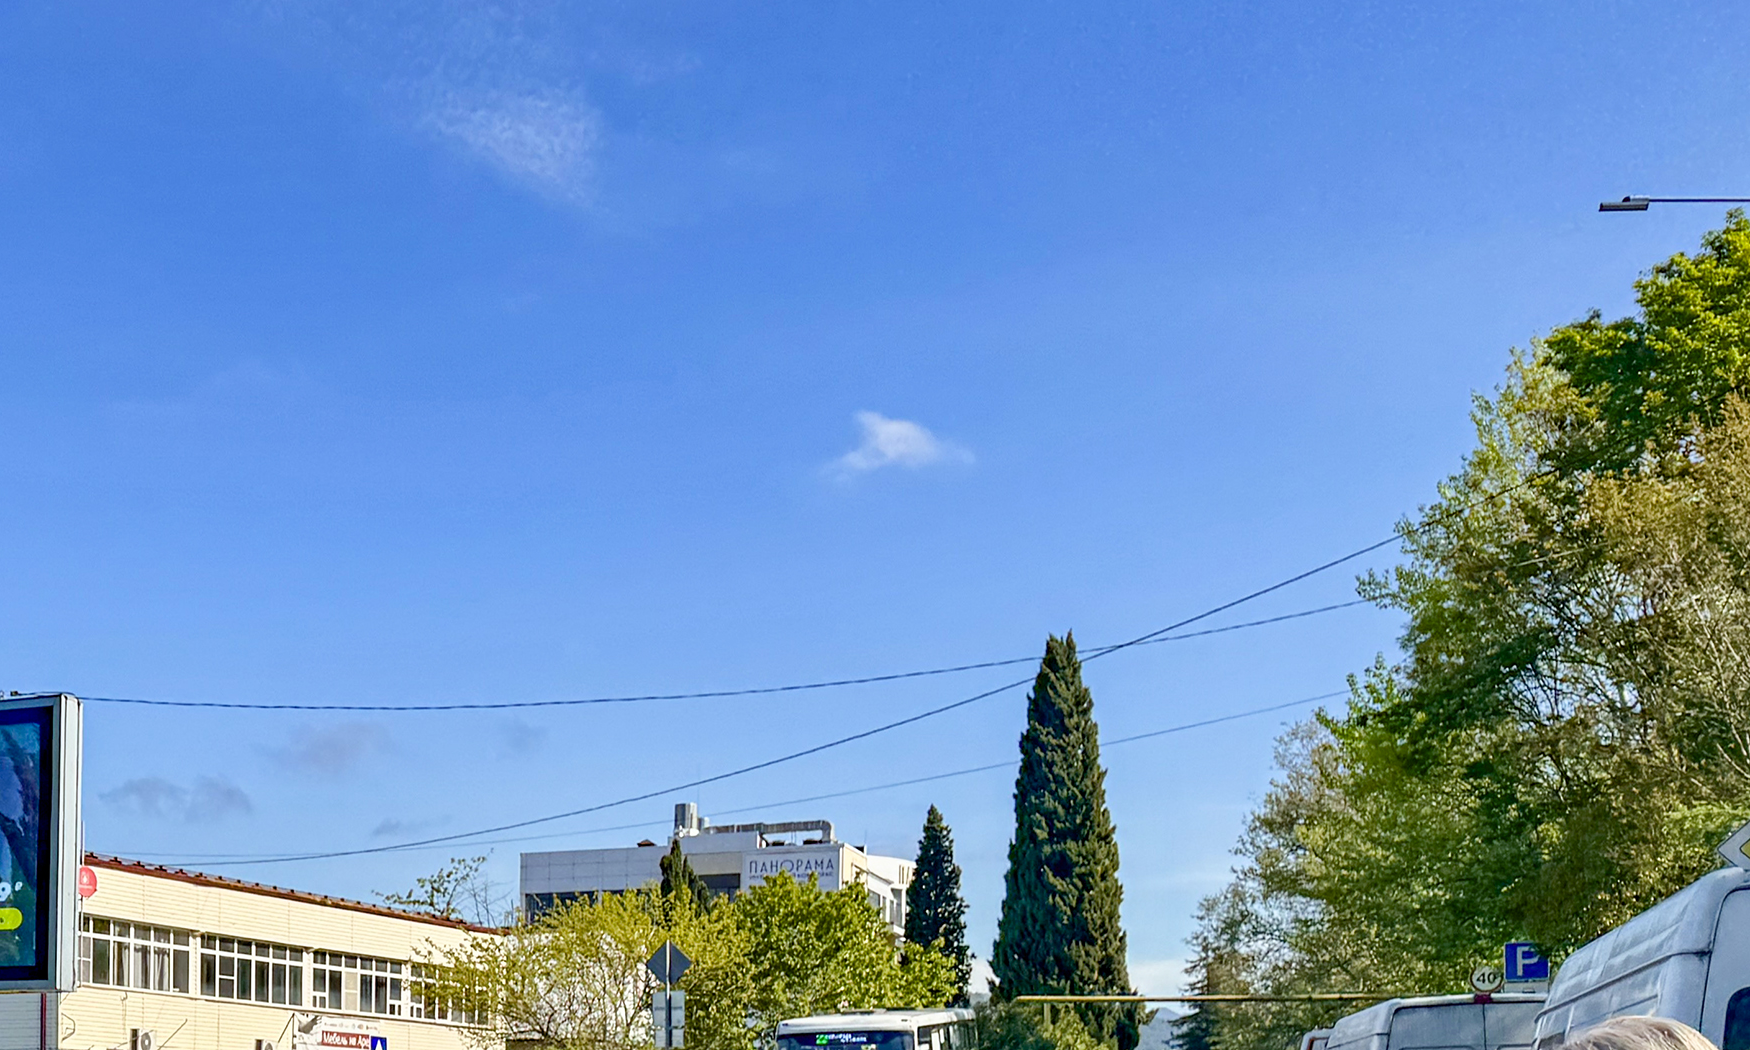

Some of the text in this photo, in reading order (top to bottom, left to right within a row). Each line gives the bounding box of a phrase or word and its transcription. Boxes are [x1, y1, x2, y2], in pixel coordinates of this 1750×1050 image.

[749, 858, 834, 874] ПАНОРАМА
[1516, 945, 1540, 977] P
[1476, 972, 1497, 984] 40
